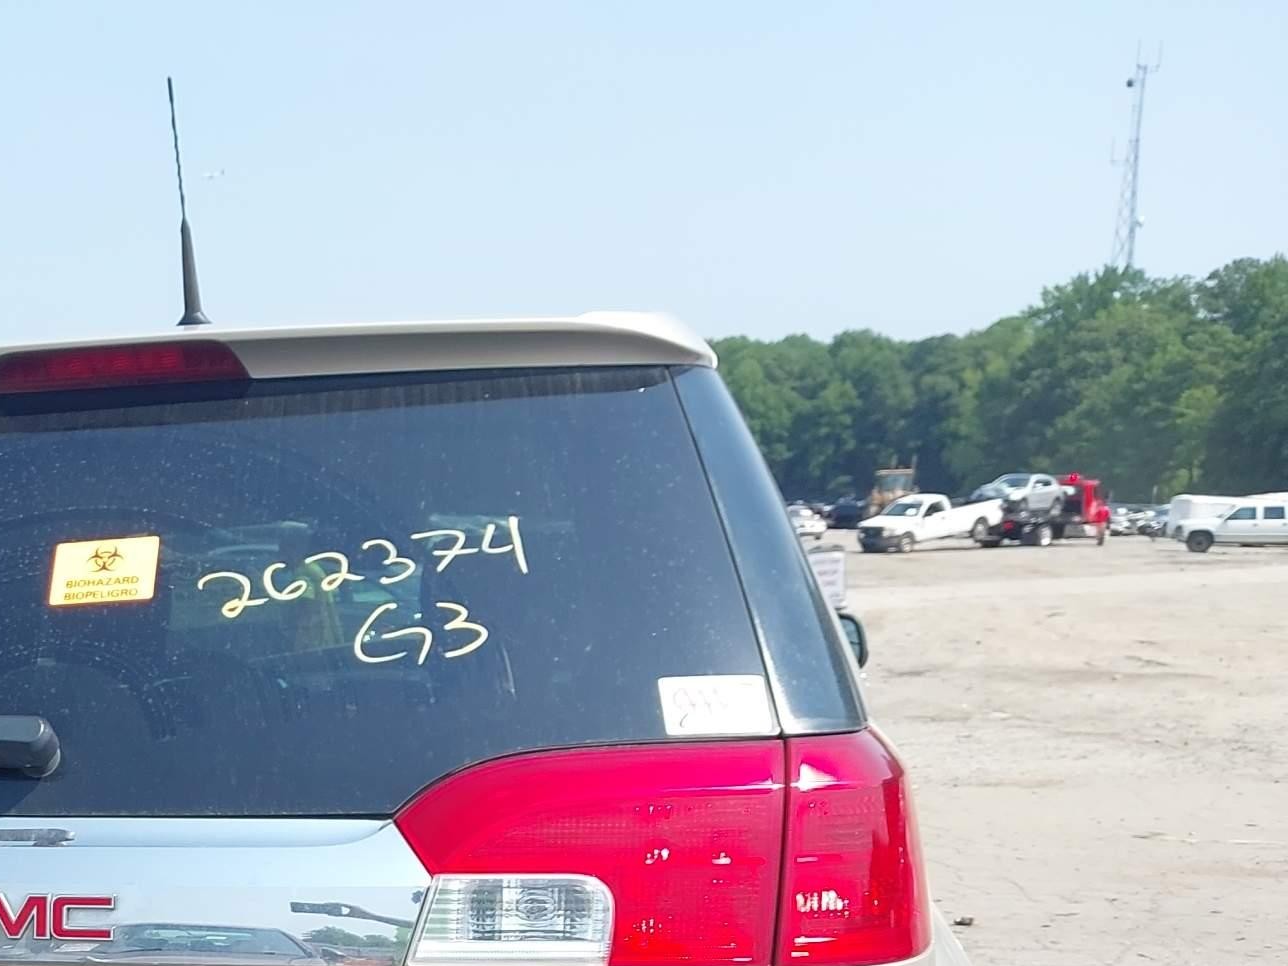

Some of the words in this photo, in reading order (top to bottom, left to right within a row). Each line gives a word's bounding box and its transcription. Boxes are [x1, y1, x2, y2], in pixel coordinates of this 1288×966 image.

[65, 575, 140, 589] BIOHAZARD
[198, 516, 528, 618] 262374
[63, 588, 139, 601] BIOPELIGRO
[353, 602, 489, 665] G3
